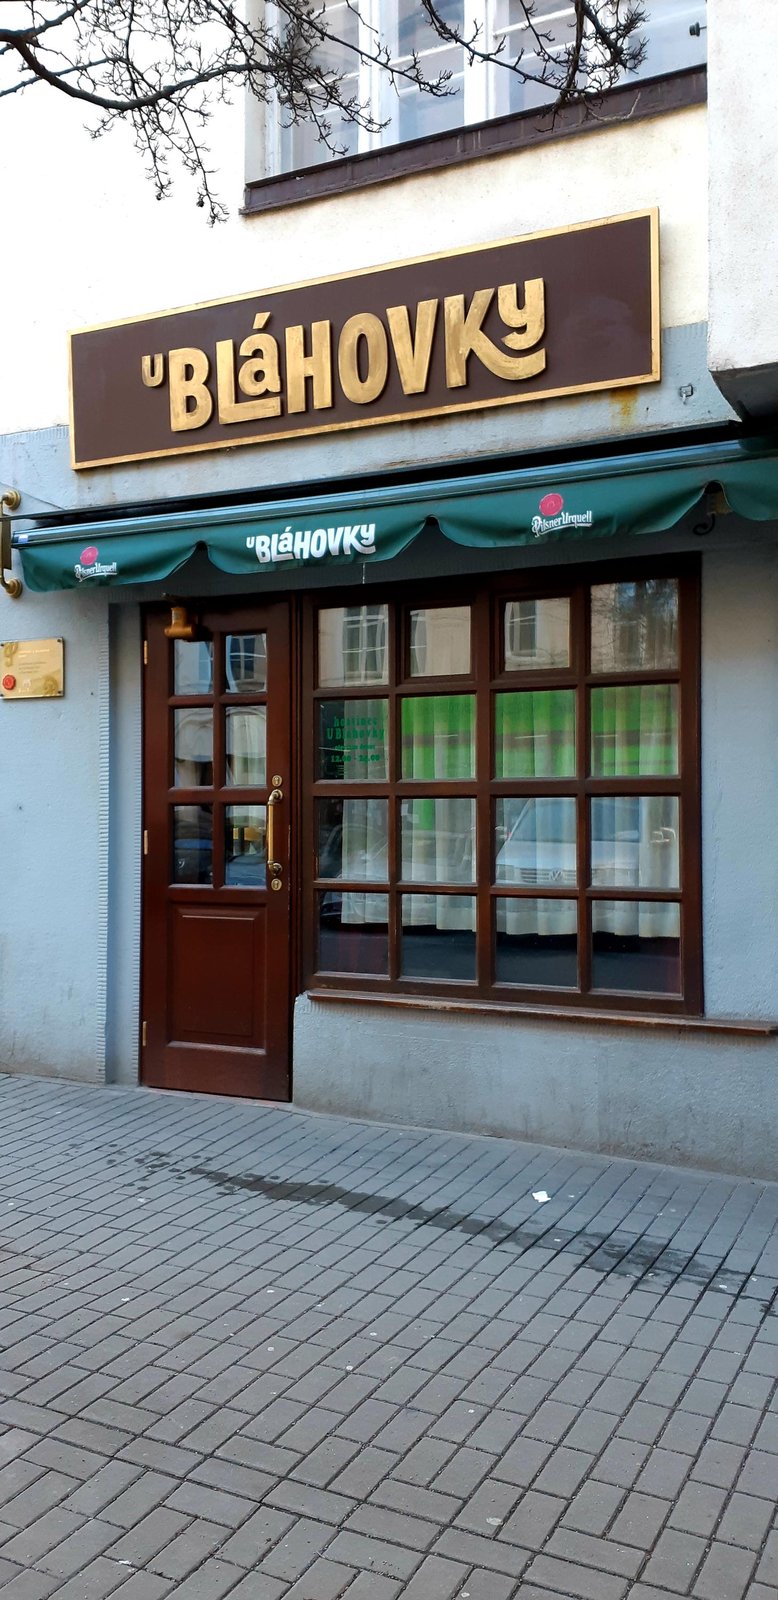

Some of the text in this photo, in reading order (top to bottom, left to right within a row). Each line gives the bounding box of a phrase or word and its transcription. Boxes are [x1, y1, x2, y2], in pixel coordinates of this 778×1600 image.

[141, 353, 164, 388] U
[531, 510, 593, 538] Pilsner Urquell
